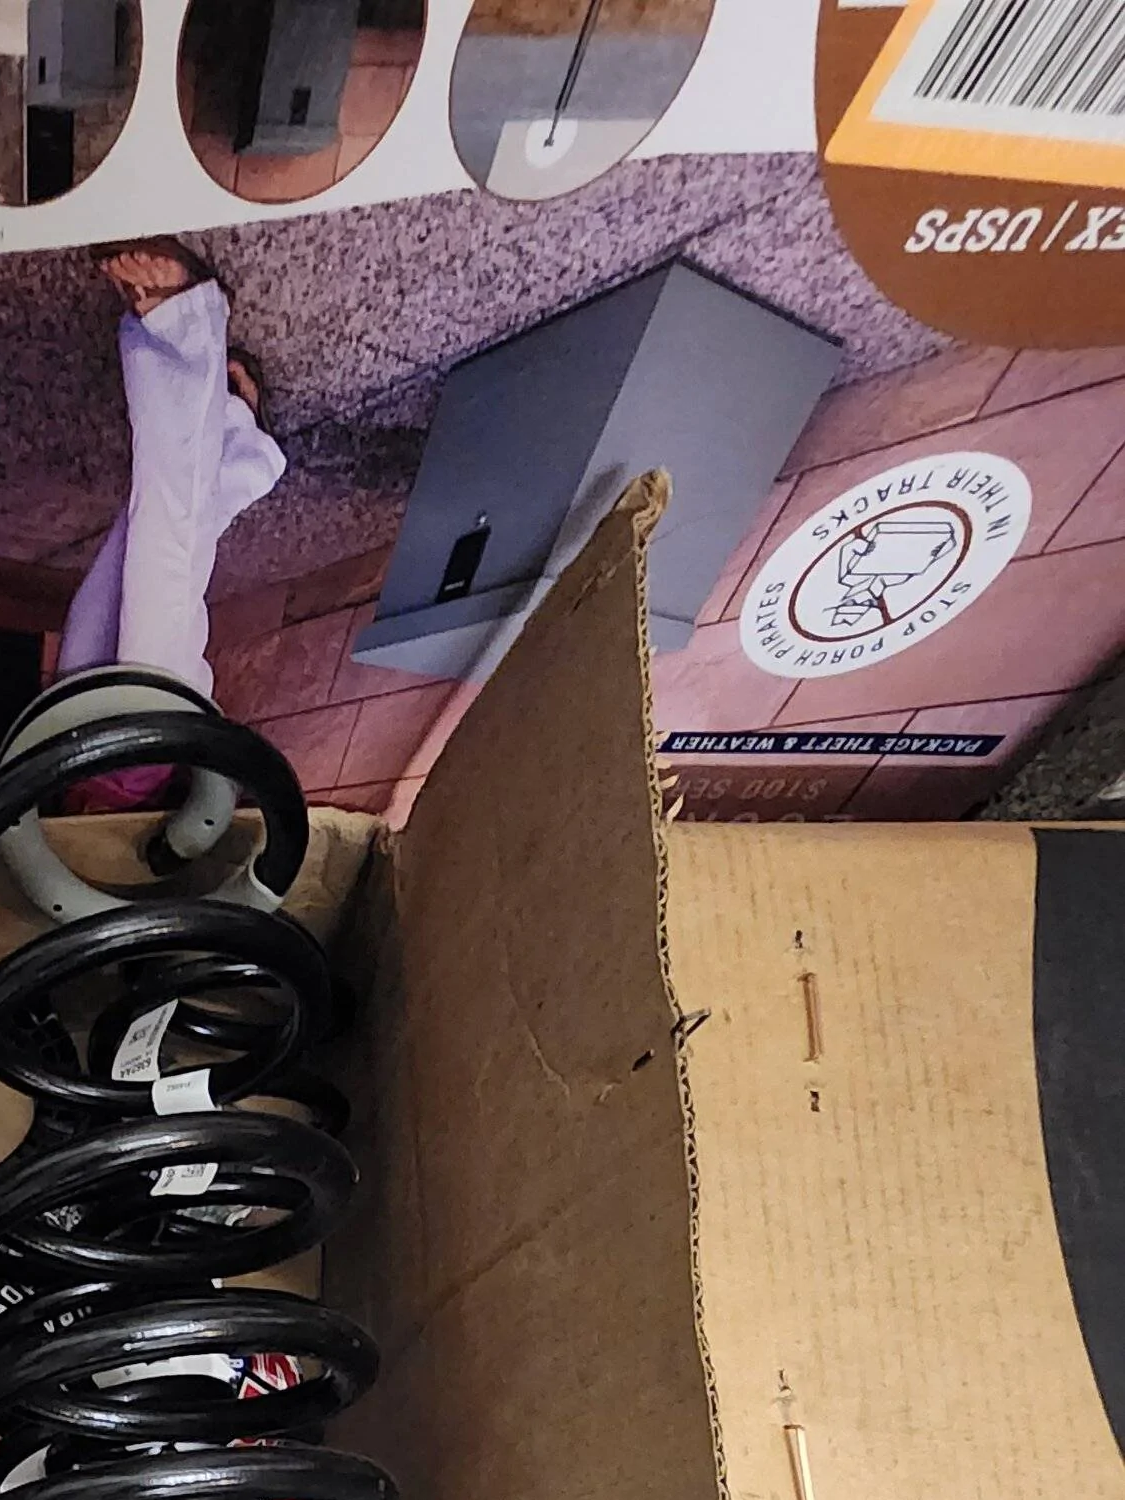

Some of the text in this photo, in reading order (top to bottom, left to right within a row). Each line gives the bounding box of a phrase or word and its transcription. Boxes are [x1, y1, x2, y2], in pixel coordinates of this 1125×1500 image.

[904, 207, 1043, 253] USPS
[812, 467, 1011, 541] IN THEIR TRACKS
[756, 581, 972, 666] STOP PORCH PIRATES
[671, 736, 775, 751] WEATHER
[782, 737, 794, 751] &
[801, 736, 875, 752] THEFT
[879, 737, 983, 753] PACKAGE
